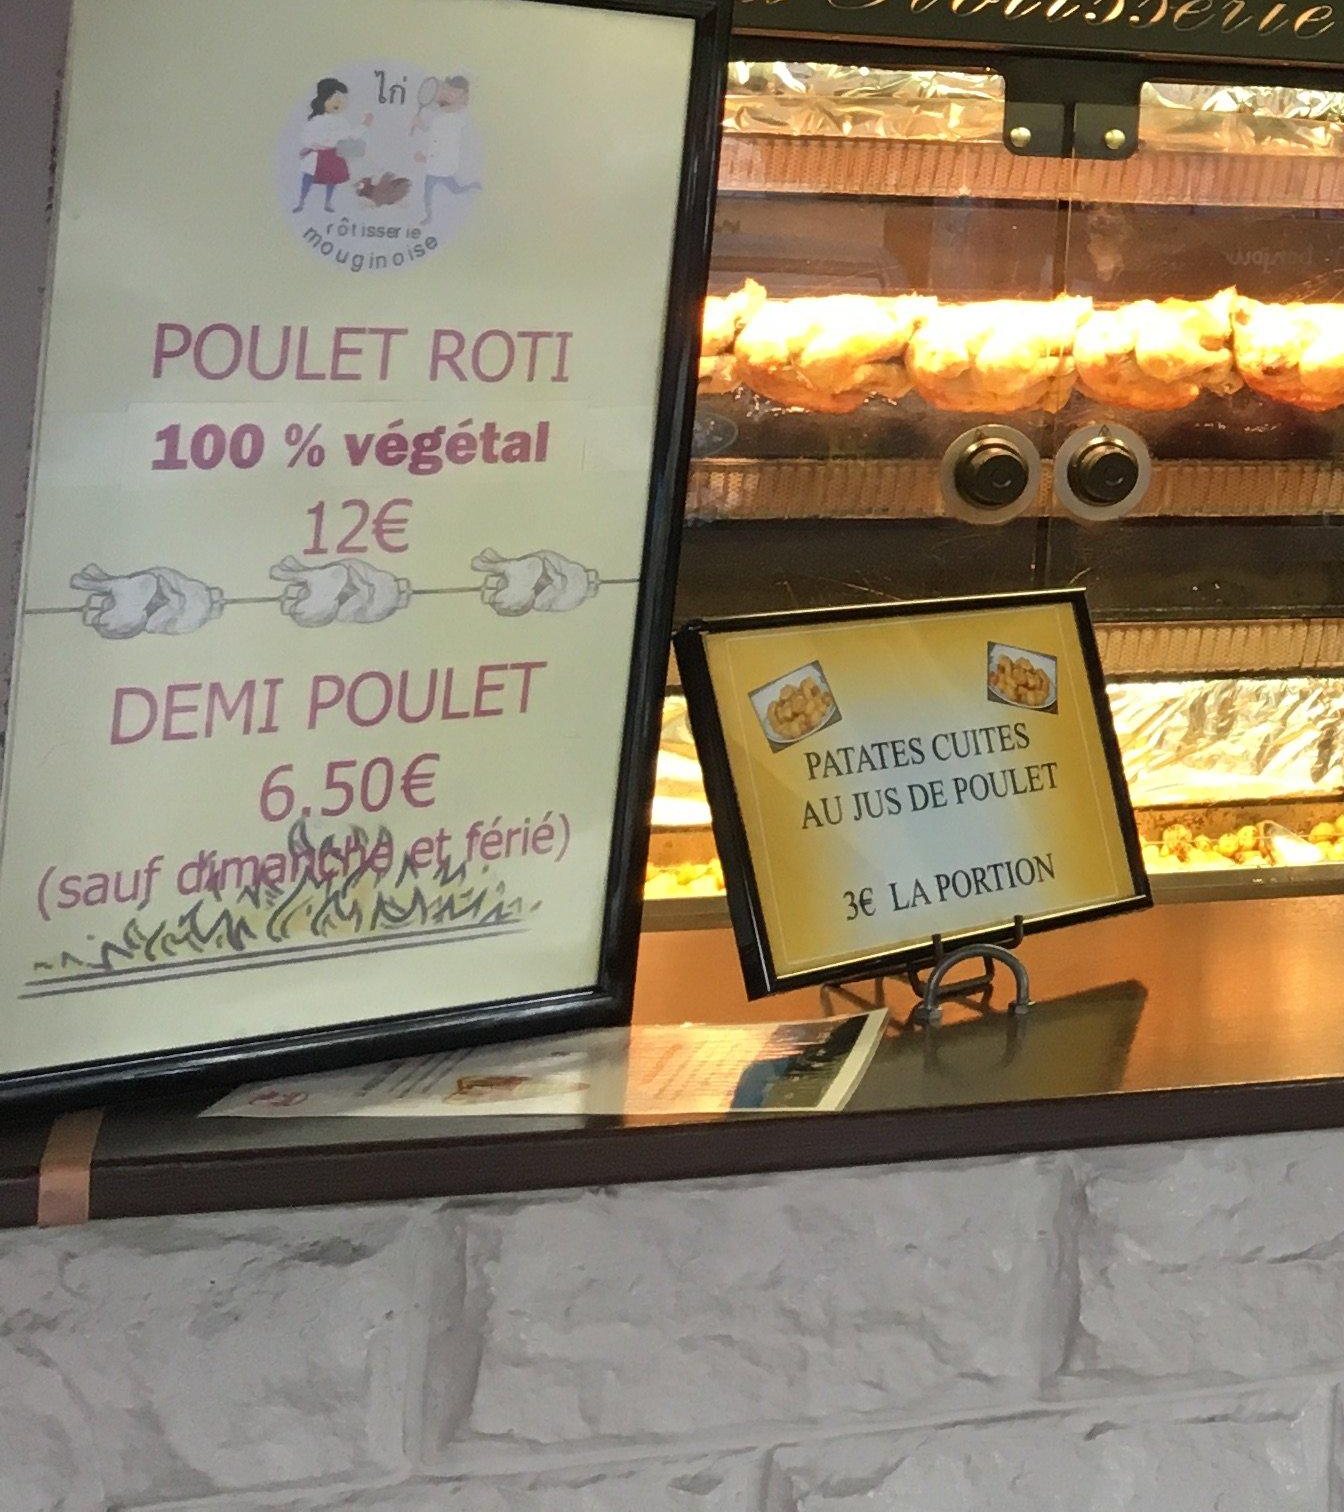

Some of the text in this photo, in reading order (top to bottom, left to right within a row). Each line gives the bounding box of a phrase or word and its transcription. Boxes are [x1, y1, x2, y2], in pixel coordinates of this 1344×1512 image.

[302, 226, 438, 273] mouginoise
[326, 216, 422, 239] rôtisserie
[151, 322, 574, 383] POULET ROTI
[151, 418, 550, 476] 100 % végétal
[302, 498, 413, 556] 12€
[108, 661, 547, 746] DEMI POULET
[804, 722, 1031, 782] PATATES CUITES
[259, 752, 441, 822] 6.50€
[801, 762, 1058, 831] AU JUS DE POULET
[36, 811, 571, 921] (sauf dimanche et férié)
[842, 852, 1057, 922] 3€ LA PORTION
